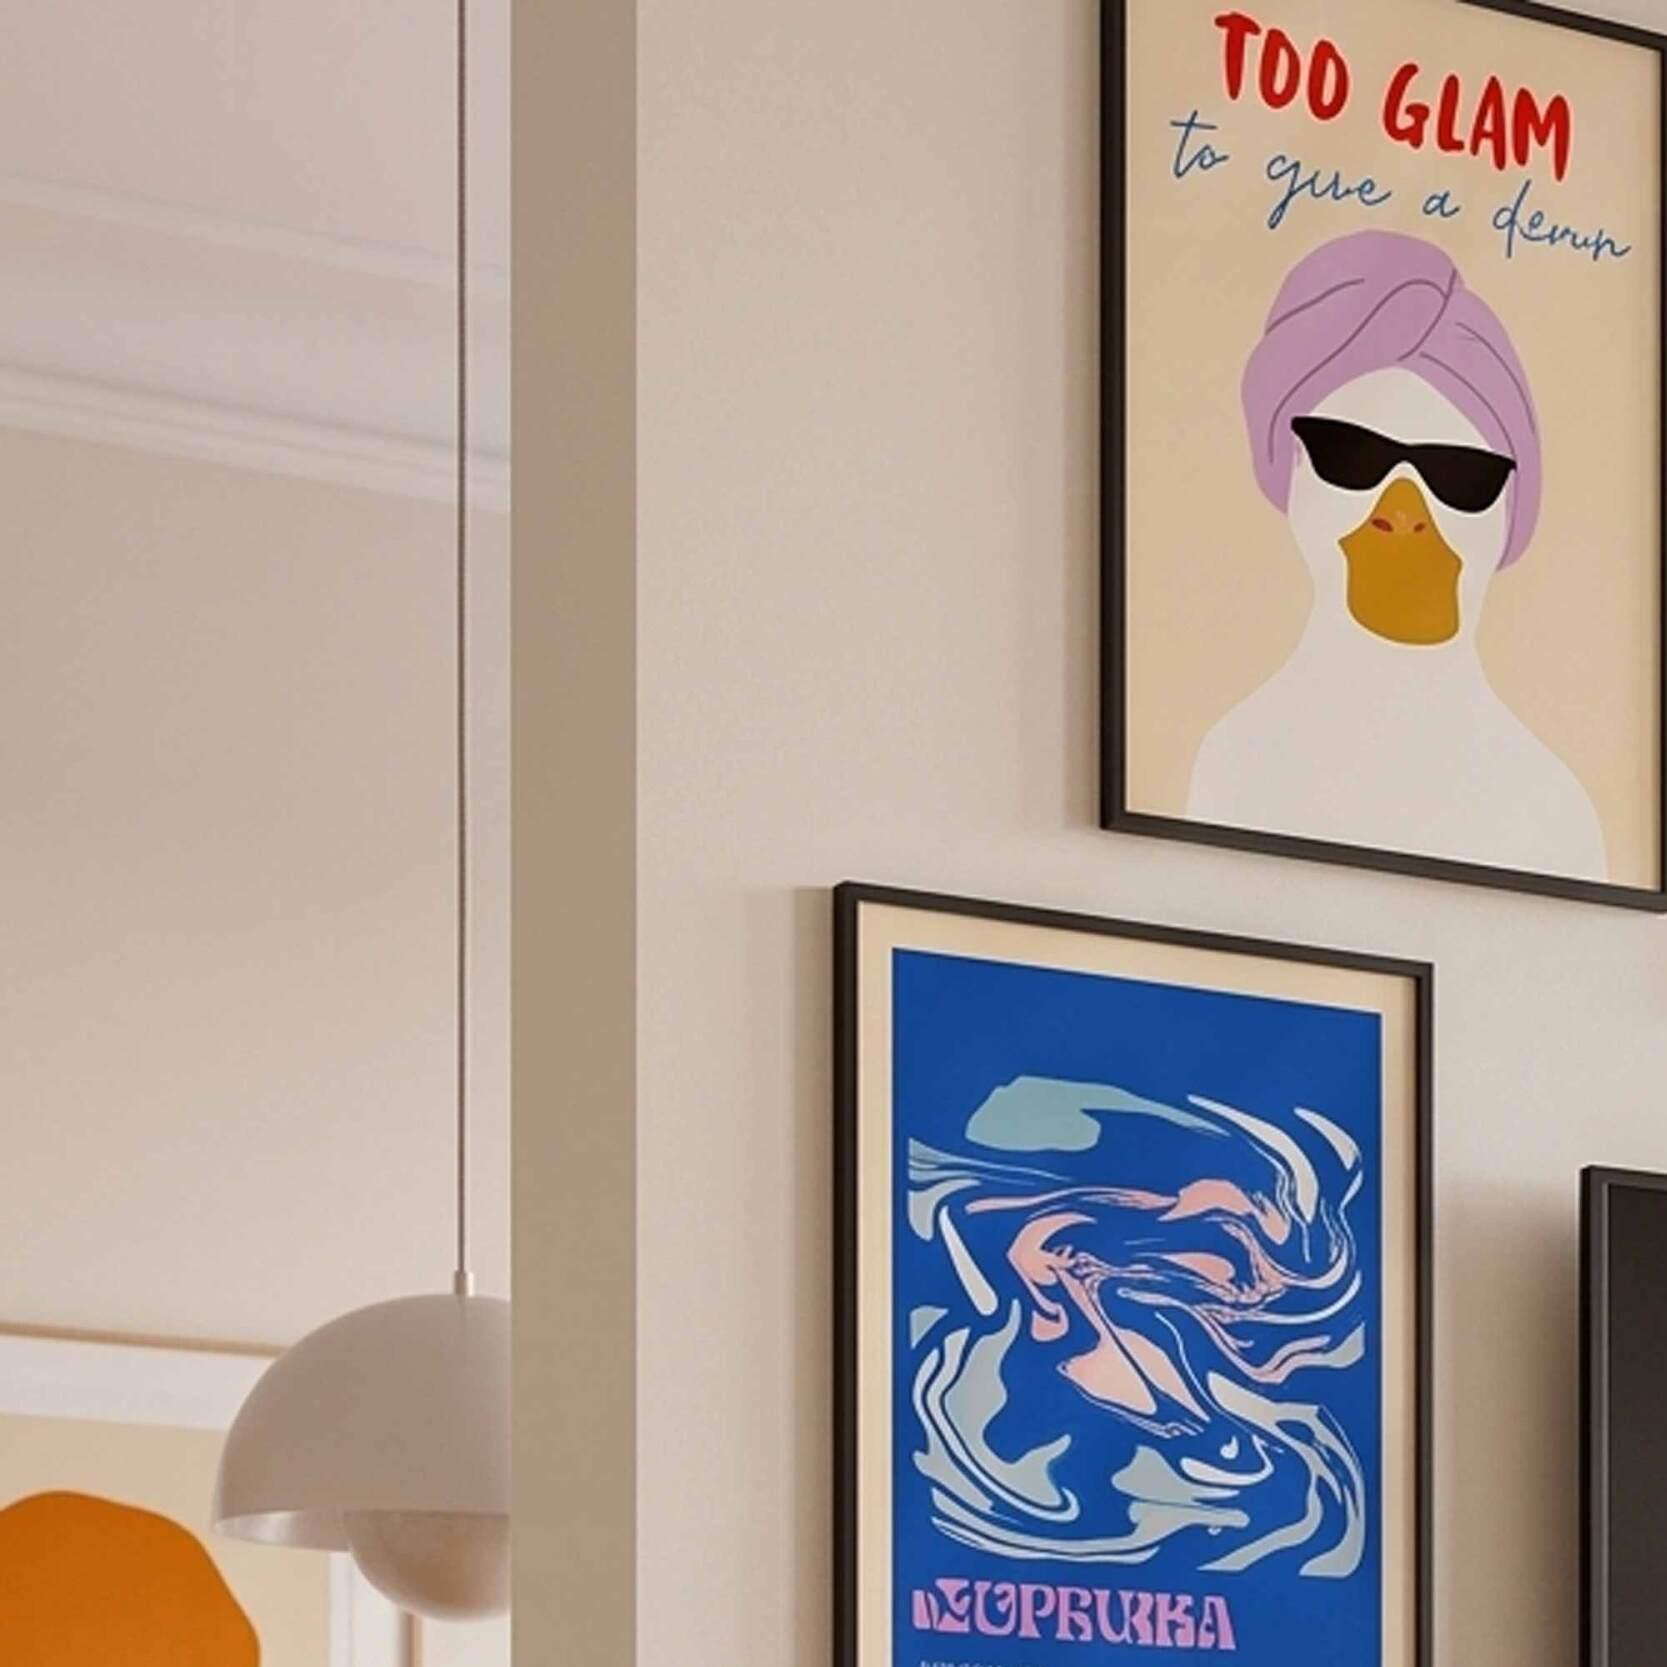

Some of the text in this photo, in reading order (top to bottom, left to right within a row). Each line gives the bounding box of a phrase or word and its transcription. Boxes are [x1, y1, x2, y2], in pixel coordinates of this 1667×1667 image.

[1170, 110, 1229, 178] to
[1423, 190, 1460, 217] a
[1214, 12, 1571, 182] TOO GLAM
